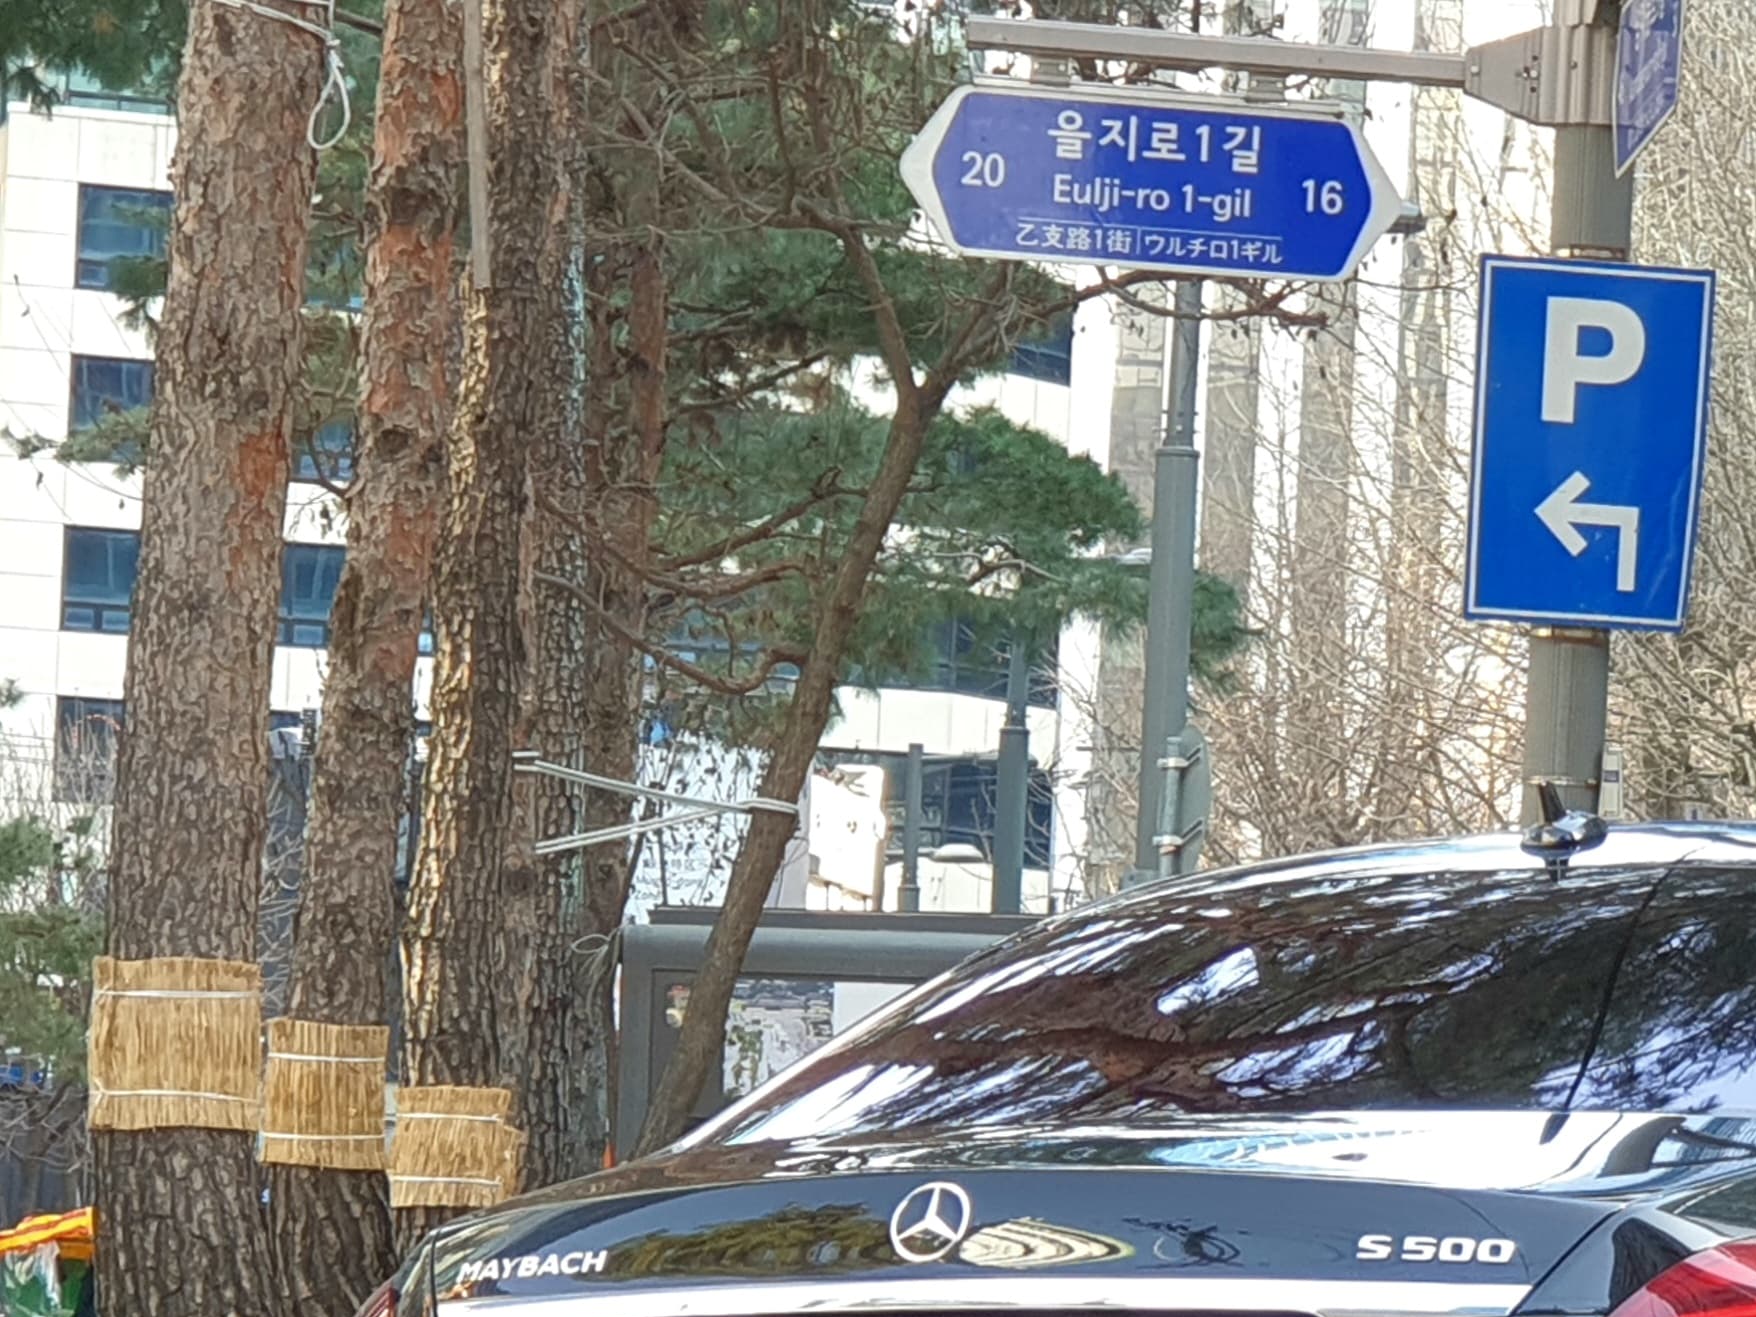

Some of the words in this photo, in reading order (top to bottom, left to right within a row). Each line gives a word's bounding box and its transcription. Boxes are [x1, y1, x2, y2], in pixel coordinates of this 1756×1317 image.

[1047, 109, 1261, 173] 을지로1길
[960, 150, 1006, 188] 20
[1053, 173, 1170, 212] Eulji-ro
[1182, 184, 1251, 222] 1-gil
[1302, 178, 1344, 215] 16
[1015, 223, 1131, 254] 乙支路1街
[1541, 296, 1646, 423] P
[456, 1249, 608, 1284] MAYBACH
[1356, 1234, 1393, 1260] S
[1401, 1235, 1516, 1264] 500
